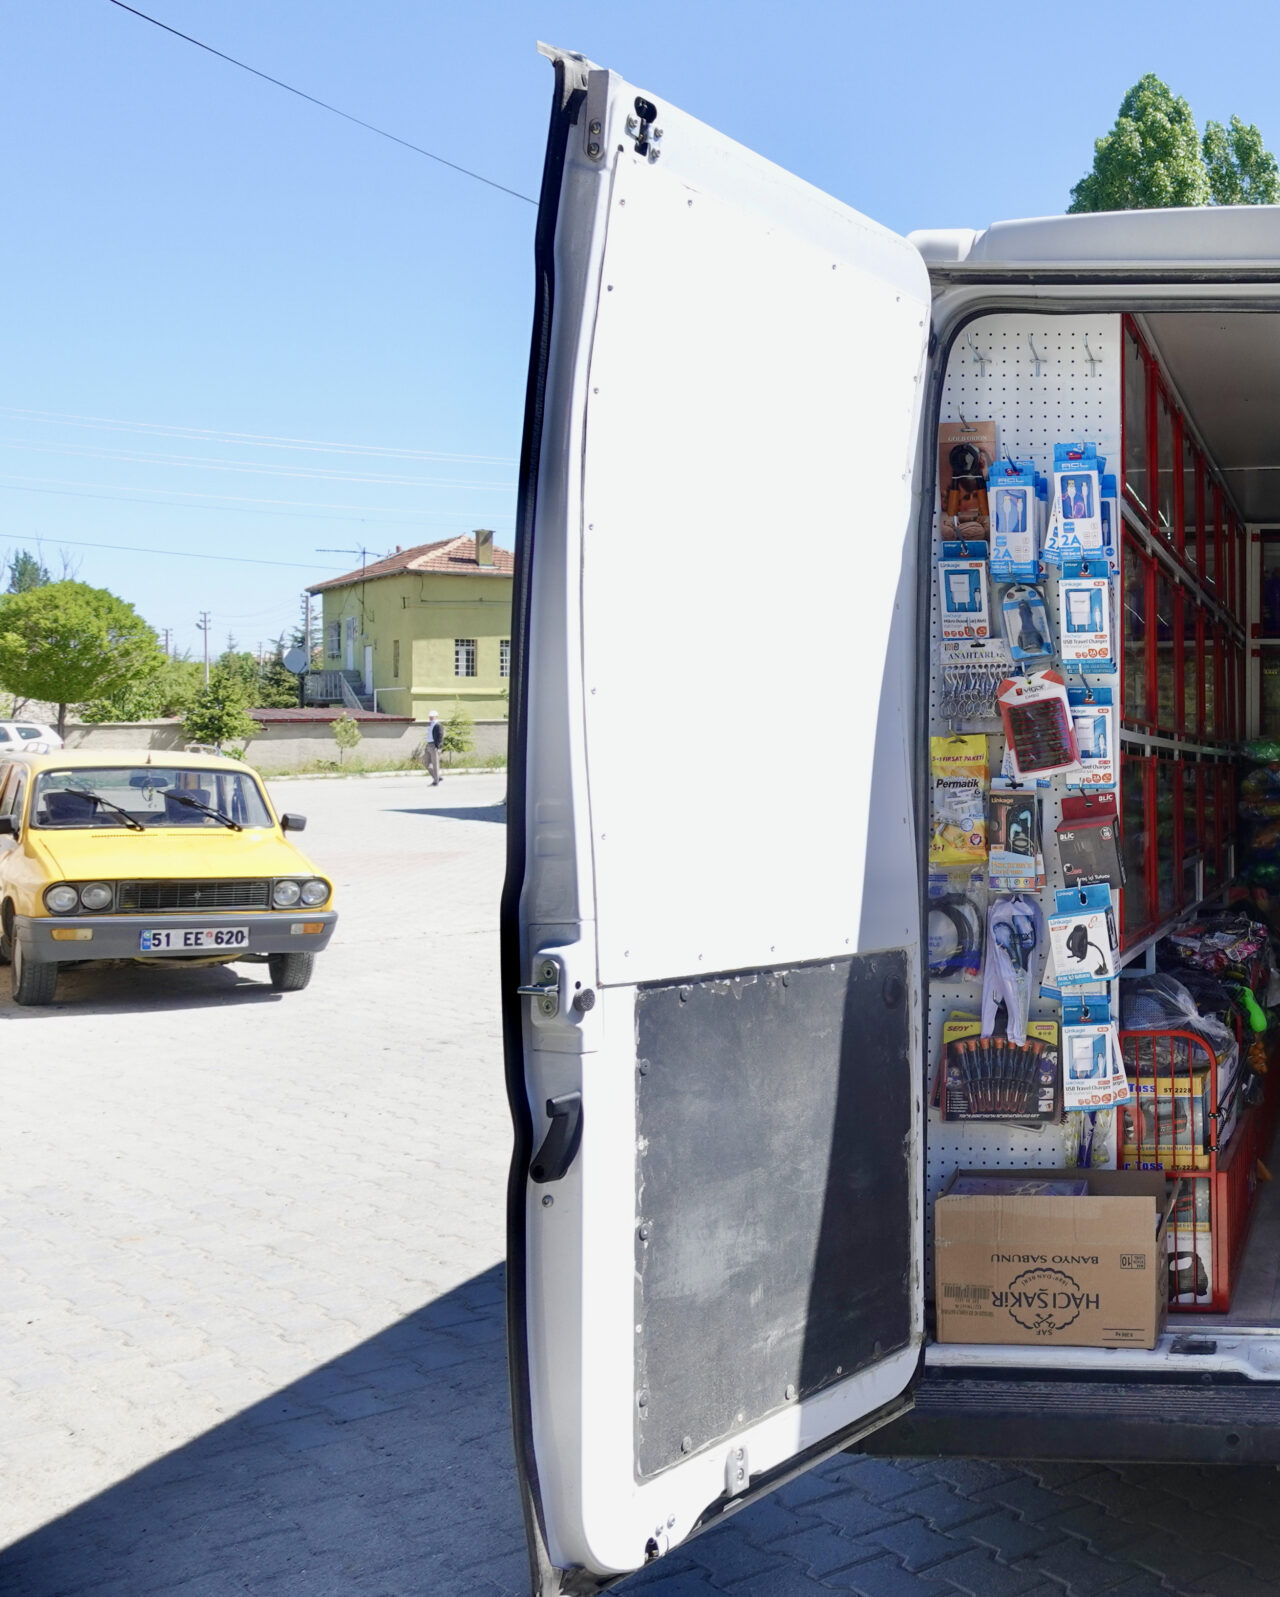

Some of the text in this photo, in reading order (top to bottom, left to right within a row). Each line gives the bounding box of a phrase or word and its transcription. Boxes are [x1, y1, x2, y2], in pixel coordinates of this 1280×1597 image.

[1061, 534, 1081, 546] 2A
[993, 548, 1013, 560] 2A
[936, 778, 979, 789] Permatik
[152, 930, 245, 947] 51 EE 620
[991, 1254, 1099, 1265] BANYO SABUNU
[1121, 1256, 1132, 1266] 10
